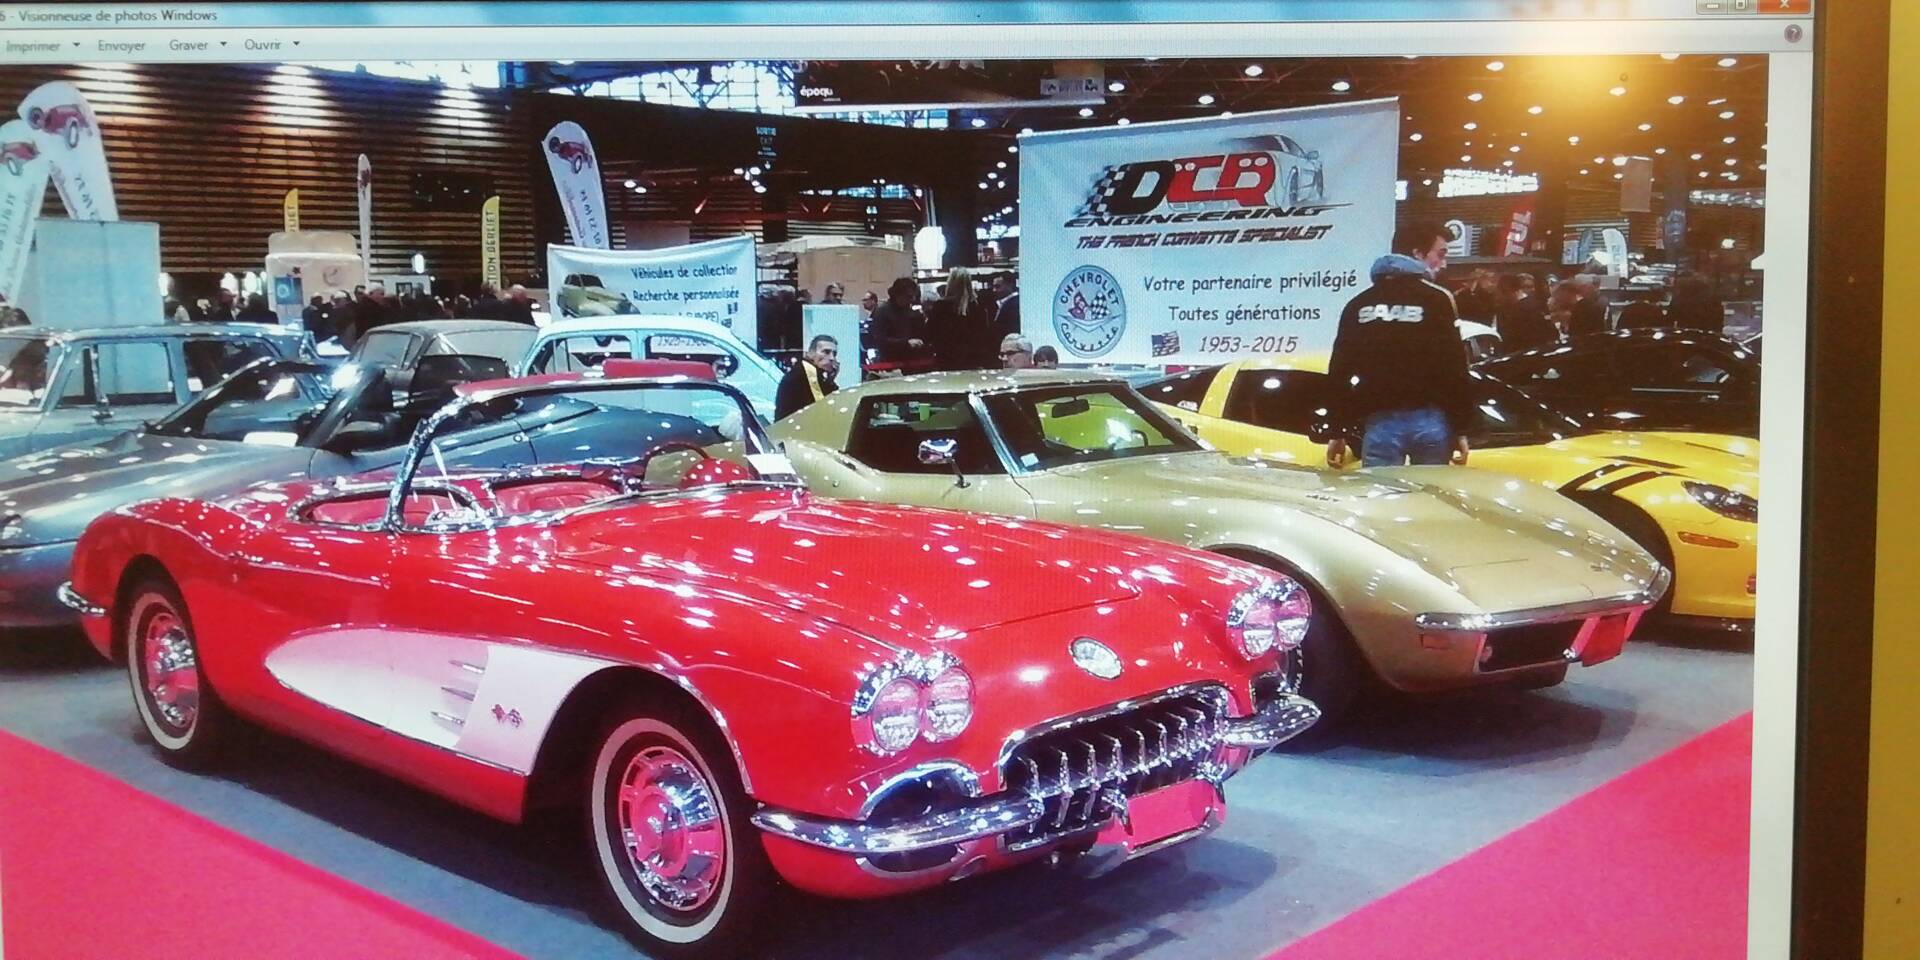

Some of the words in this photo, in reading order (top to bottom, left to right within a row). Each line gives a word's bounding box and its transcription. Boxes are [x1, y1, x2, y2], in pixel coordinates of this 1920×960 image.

[19, 10, 92, 21] Visionneuse
[95, 10, 112, 20] de
[114, 11, 157, 24] photos
[161, 9, 218, 20] Windows
[6, 40, 60, 53] Imprimer
[98, 40, 146, 53] Envoyer
[169, 40, 208, 50] Graver
[244, 38, 281, 50] Ouvrir
[1064, 205, 1328, 228] ENGINEERING
[1077, 235, 1107, 249] THE
[1105, 233, 1161, 248] FRENCH
[1161, 229, 1240, 246] CORVETTE
[1238, 225, 1334, 243] SPECIALIST
[632, 267, 674, 279] Véhicules
[677, 266, 688, 277] de
[693, 264, 737, 277] collection
[1060, 272, 1120, 305] CHEVROLET
[1144, 275, 1185, 291] Votre
[1192, 274, 1272, 295] partenaire
[1280, 269, 1357, 293] privilégié
[633, 289, 678, 301] Recherche
[1168, 305, 1219, 321] Toutes
[1226, 303, 1321, 325] générations
[1358, 304, 1424, 324] SAAB
[1198, 336, 1298, 353] 1953-2015
